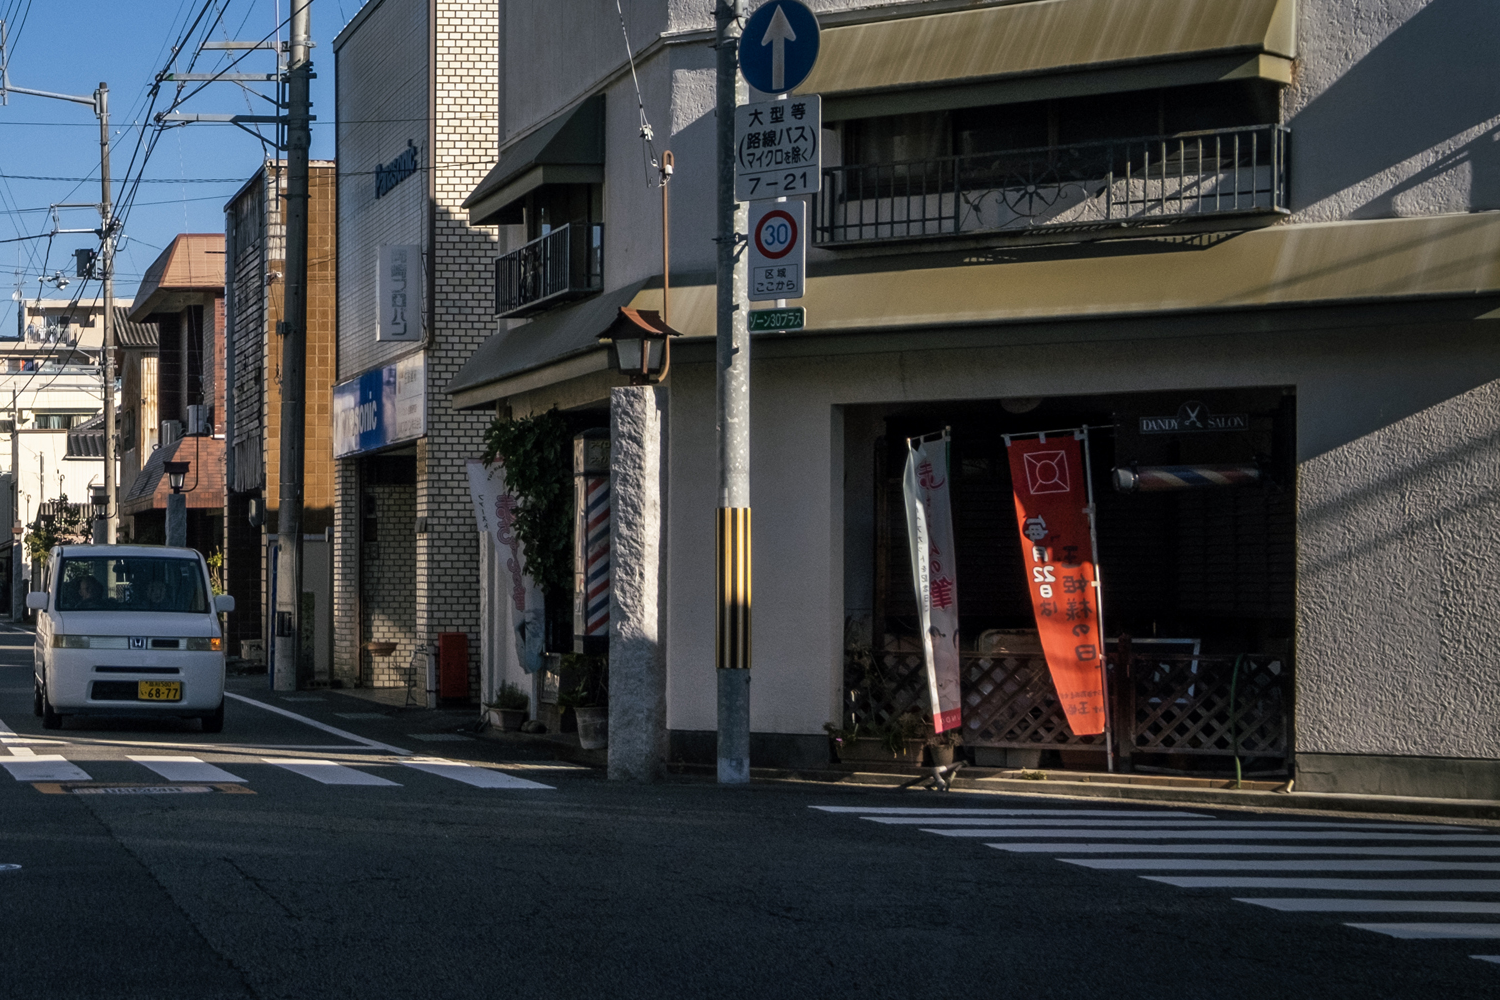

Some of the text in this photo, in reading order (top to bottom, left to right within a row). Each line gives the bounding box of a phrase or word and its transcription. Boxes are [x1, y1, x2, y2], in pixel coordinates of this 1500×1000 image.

[748, 102, 807, 127] 大型等
[375, 139, 418, 200] Panasonic
[764, 223, 788, 246] 30
[764, 267, 787, 279] 区域
[756, 280, 796, 292] ここから
[1142, 416, 1245, 431] DANDY SALON
[147, 687, 179, 699] 68-77
